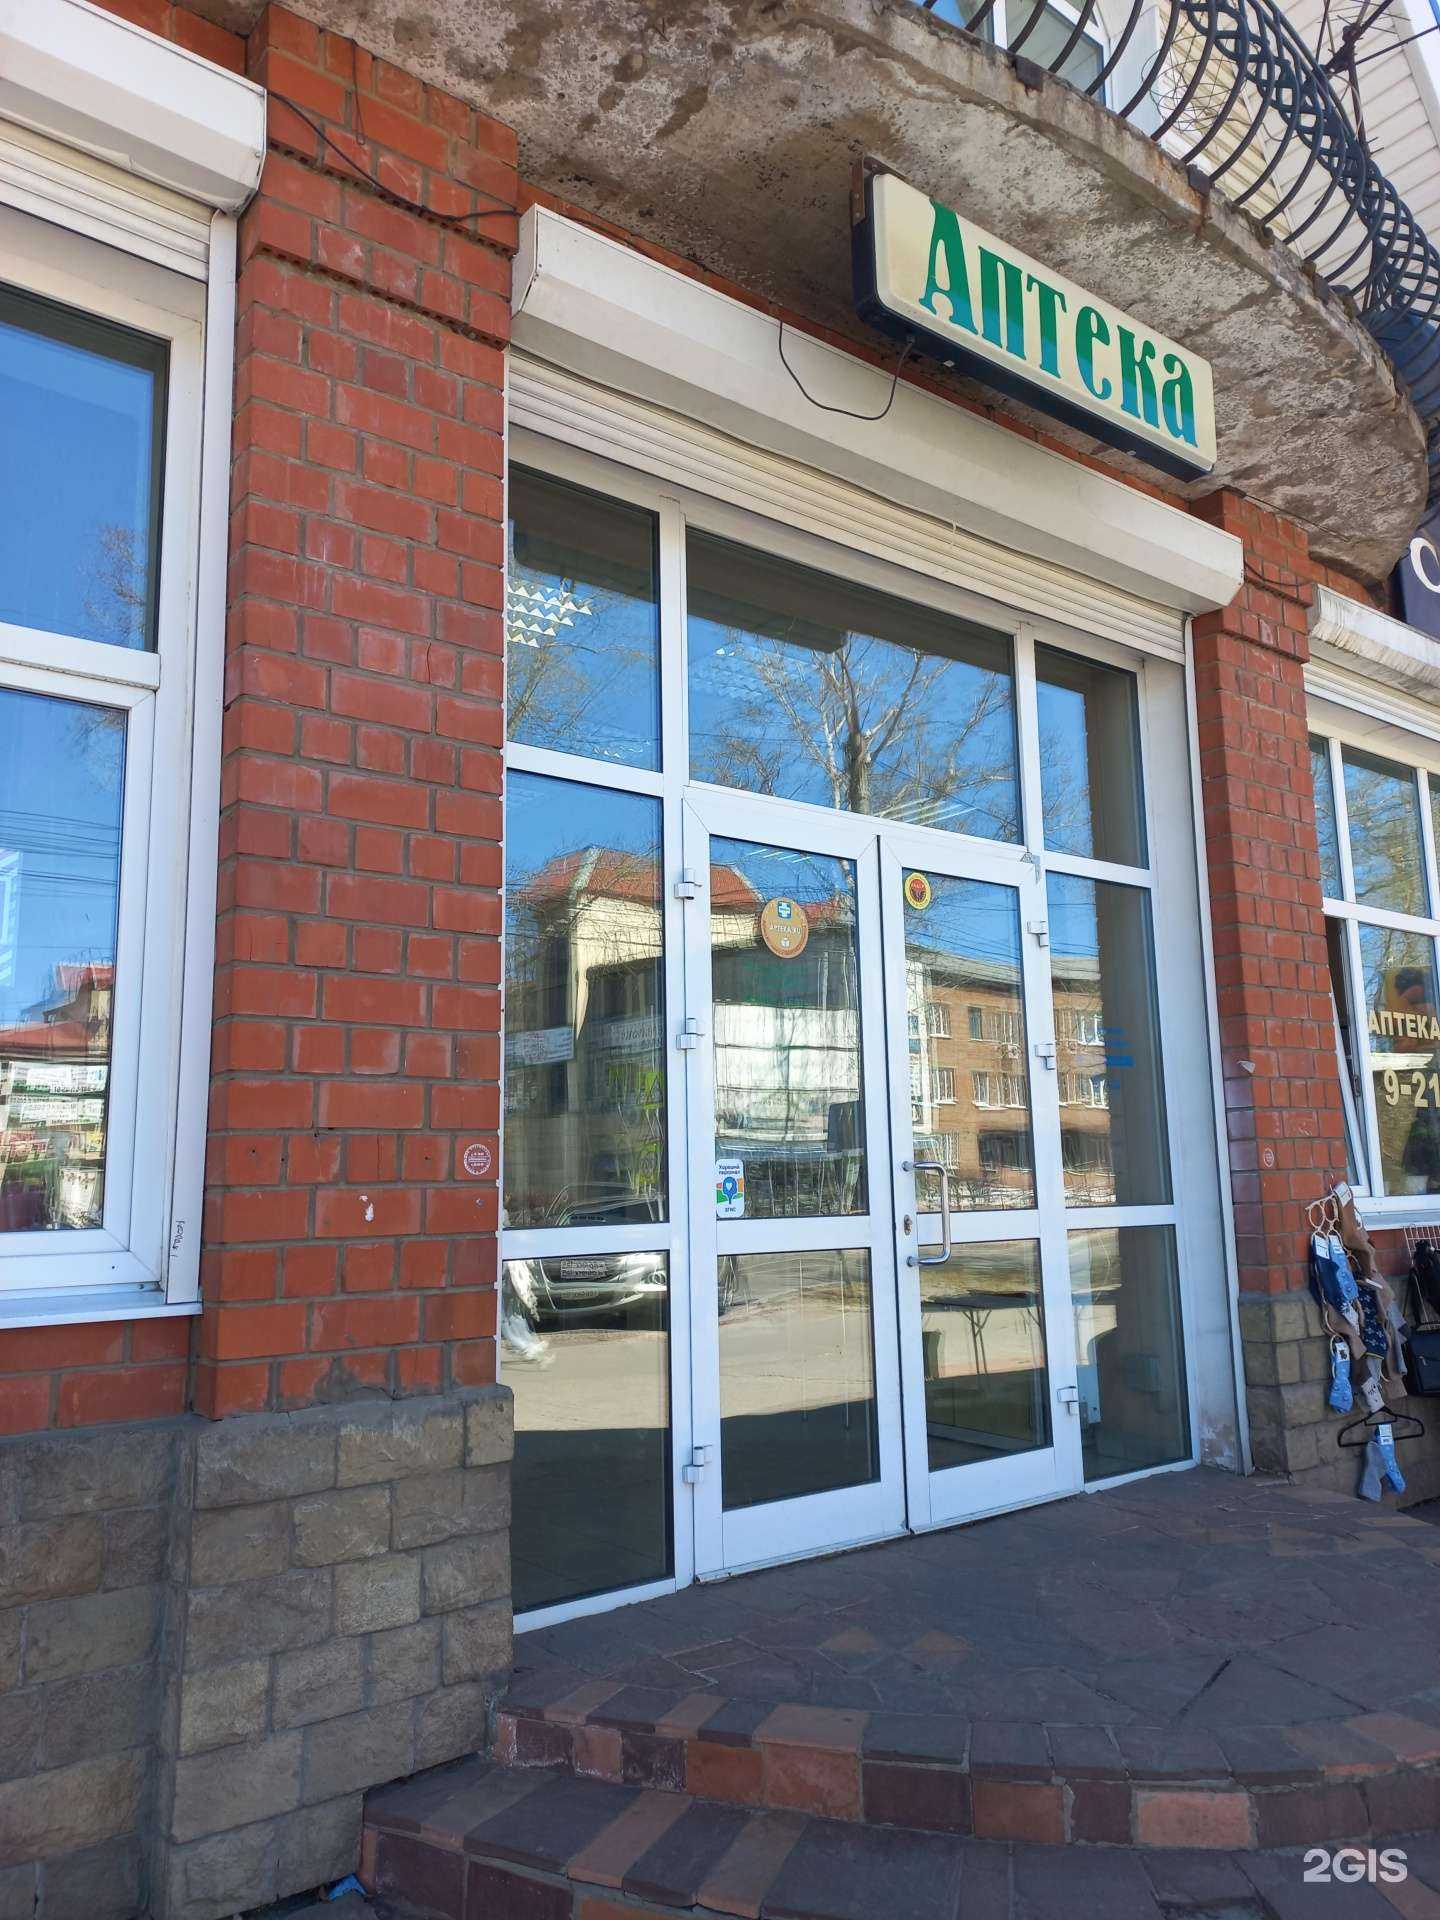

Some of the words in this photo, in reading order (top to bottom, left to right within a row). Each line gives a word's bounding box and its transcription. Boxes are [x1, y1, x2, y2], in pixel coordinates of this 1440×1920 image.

[920, 199, 1198, 448] Аптека
[1368, 1010, 1440, 1040] АПТЕКА
[1384, 1068, 1440, 1108] 9-21
